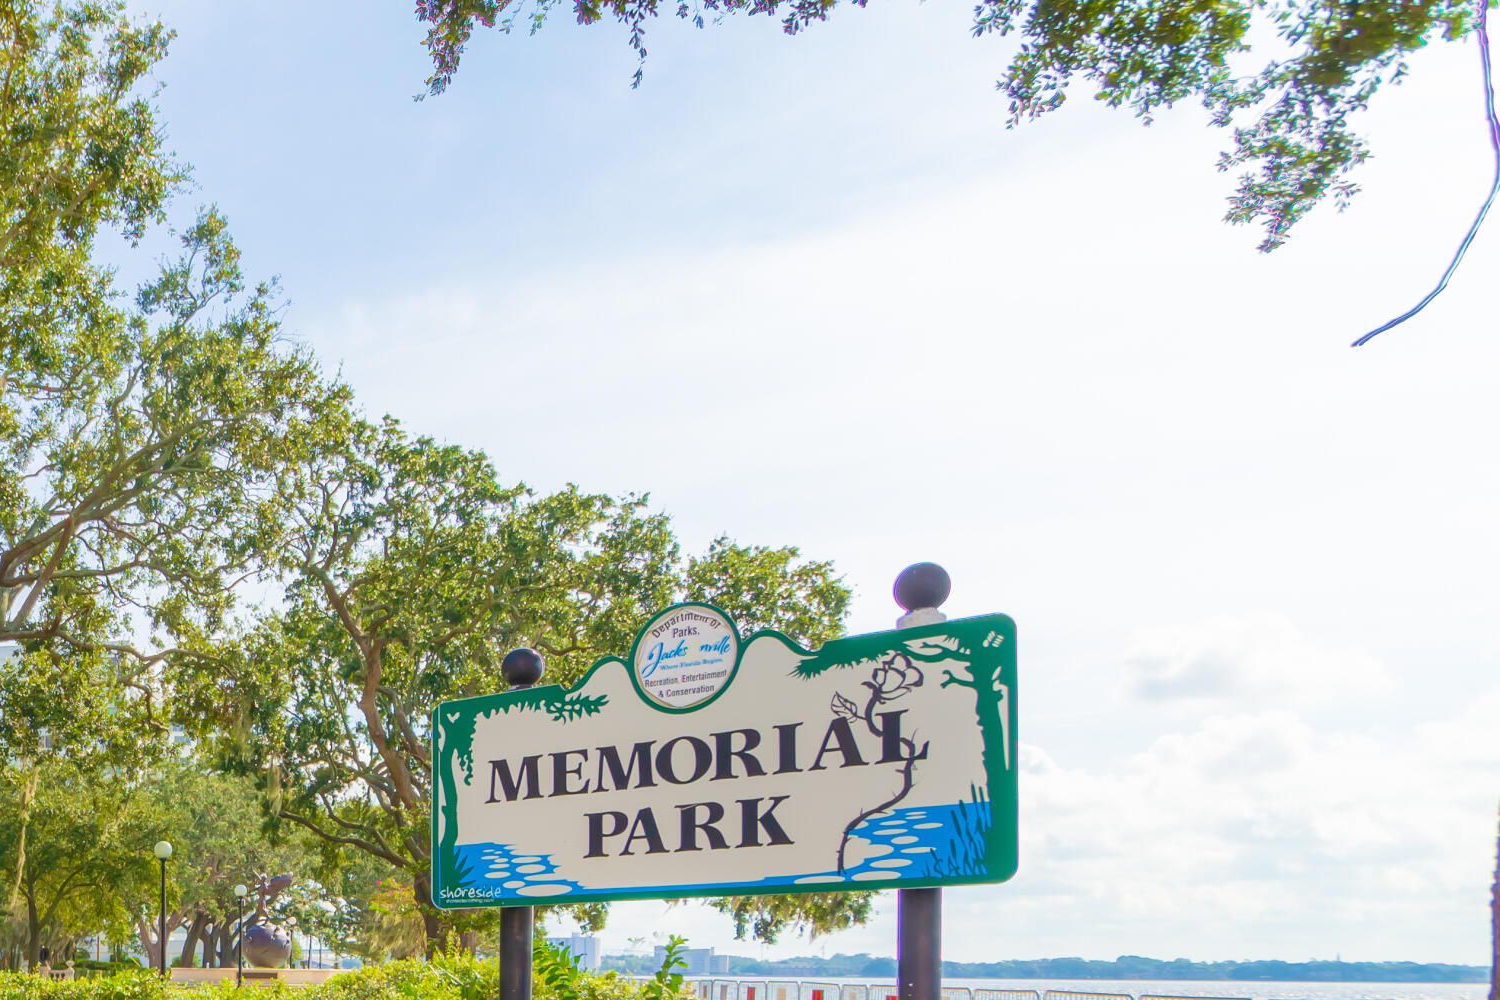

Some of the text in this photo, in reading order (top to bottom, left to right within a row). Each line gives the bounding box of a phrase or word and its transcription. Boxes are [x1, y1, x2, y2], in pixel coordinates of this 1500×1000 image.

[641, 635, 731, 678] Jacksnville
[681, 669, 727, 683] Entertainment
[666, 685, 715, 697] Conservation
[484, 709, 930, 804] MEMORIAL
[583, 795, 795, 858] PARK
[440, 885, 501, 899] shoreside
